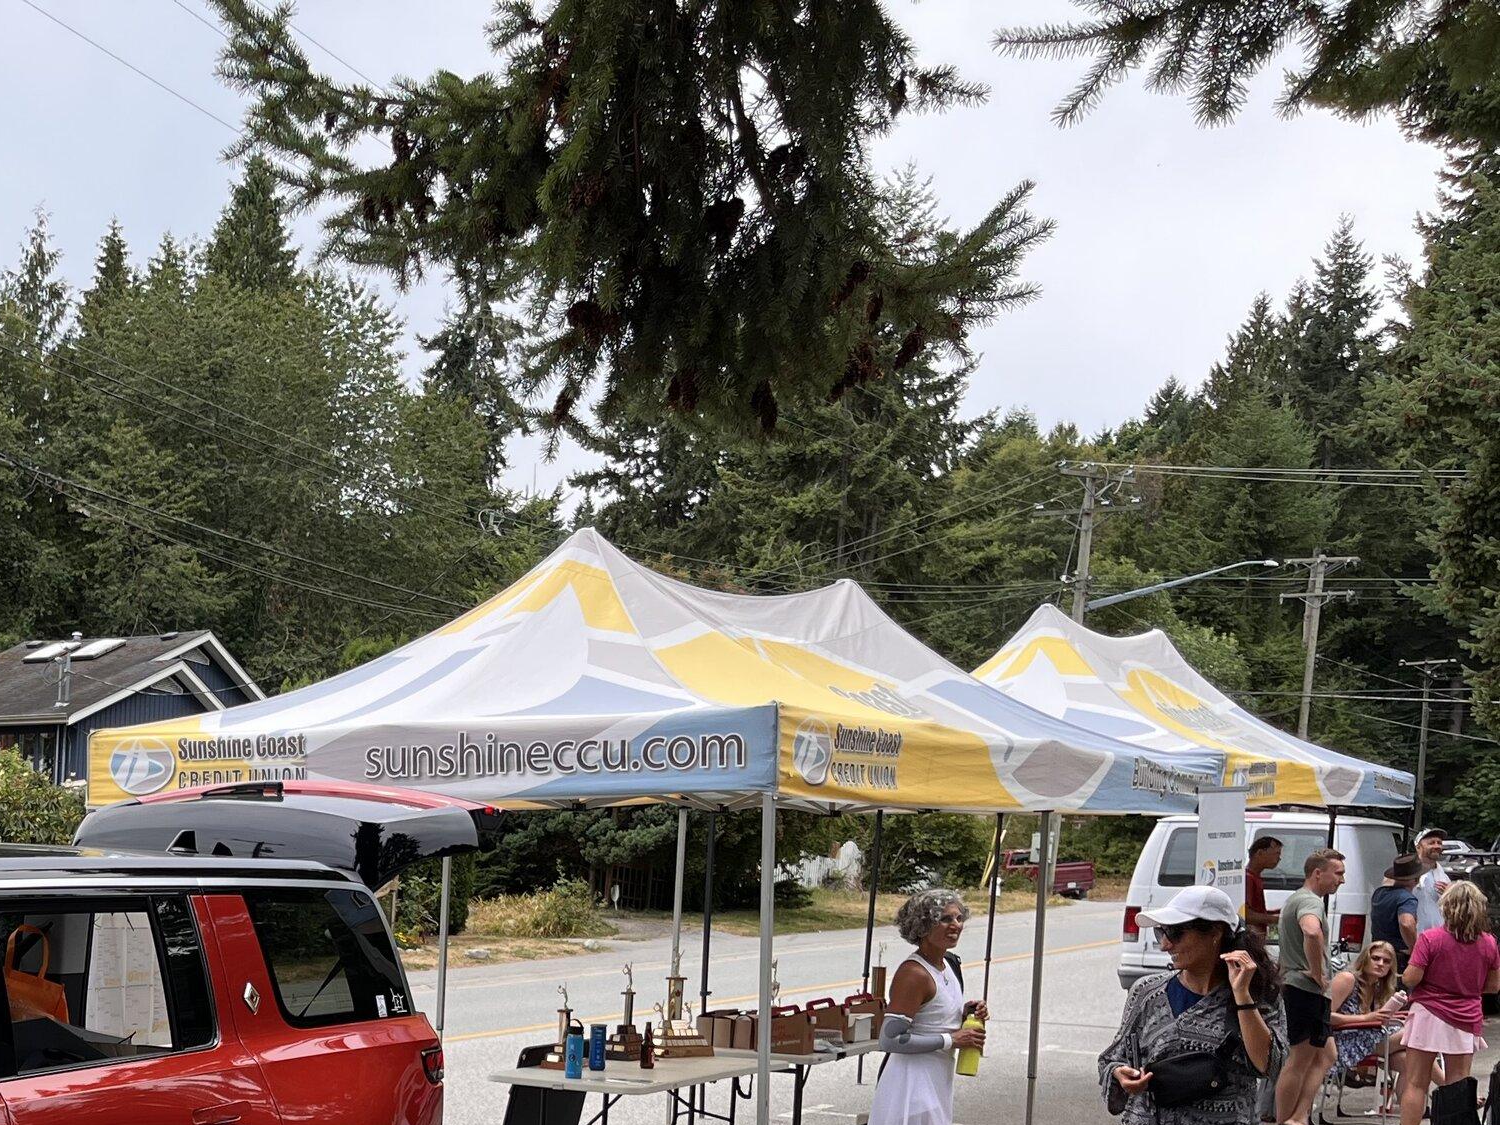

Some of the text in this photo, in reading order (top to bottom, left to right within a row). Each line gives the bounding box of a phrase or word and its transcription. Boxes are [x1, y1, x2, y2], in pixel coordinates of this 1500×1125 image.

[178, 735, 307, 760] Sunshine Coast
[834, 722, 902, 755] Sunshine Coast
[365, 730, 745, 779] sunshineccu.com
[178, 769, 241, 788] CREDIT
[830, 761, 897, 787] CREDIT UNION
